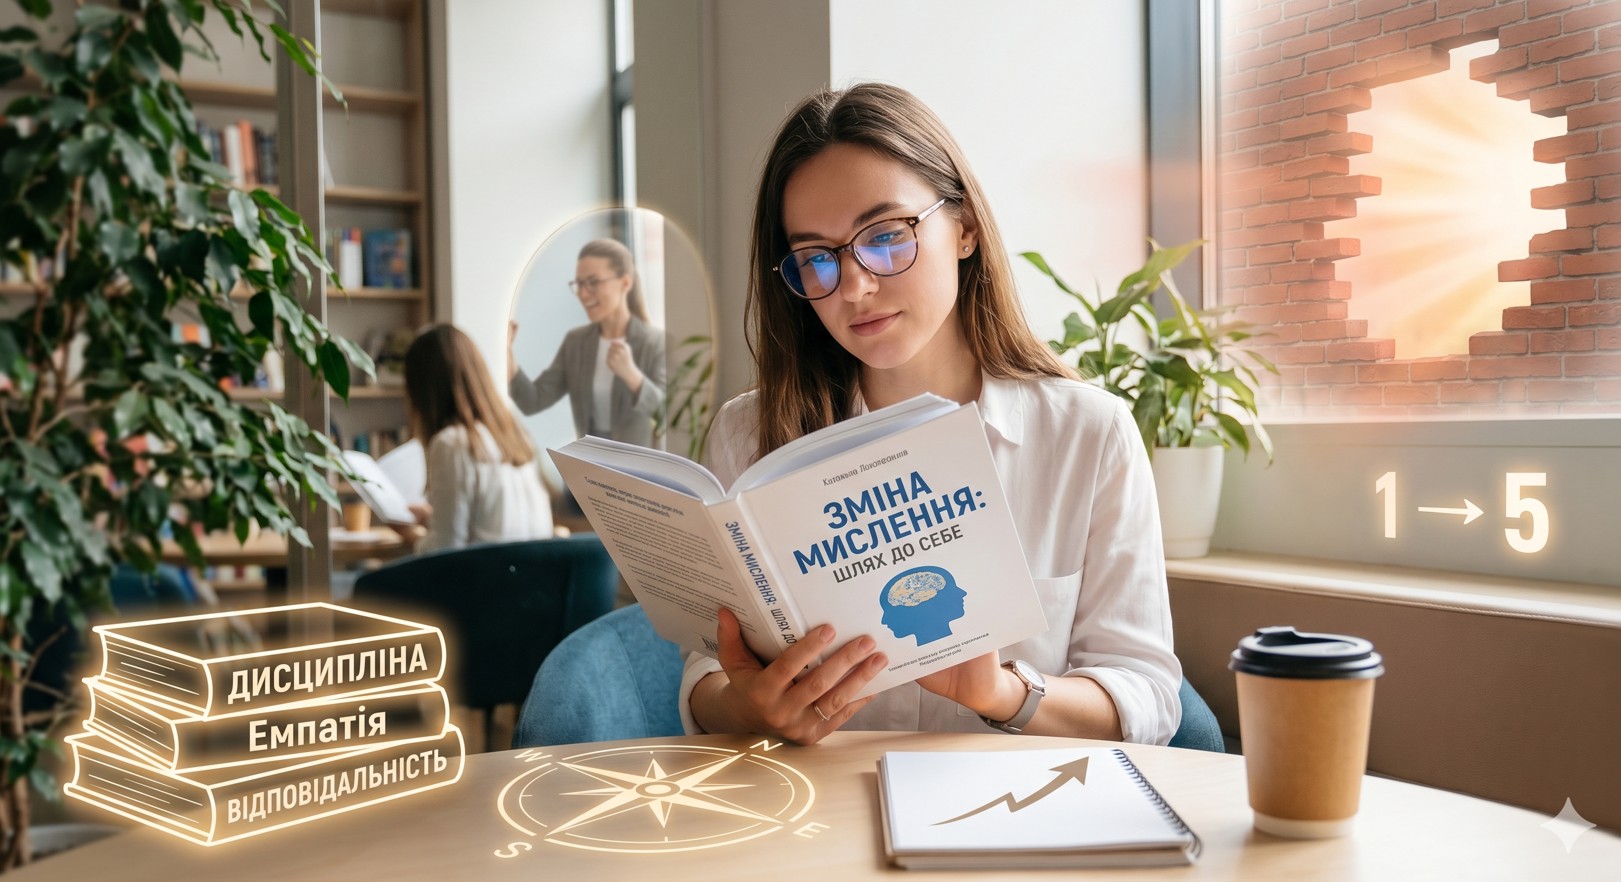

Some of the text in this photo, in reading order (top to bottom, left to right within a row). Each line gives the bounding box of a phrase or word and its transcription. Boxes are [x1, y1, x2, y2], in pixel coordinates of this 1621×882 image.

[793, 486, 986, 575] МИСЛЕННЯ:
[823, 471, 932, 529] ЗМІНА
[725, 521, 797, 644] ЗМІНА МИСЛЕННЯ: ШЛЯХ ДО
[833, 524, 963, 583] ШЛЯХ ДО СЕБЕ
